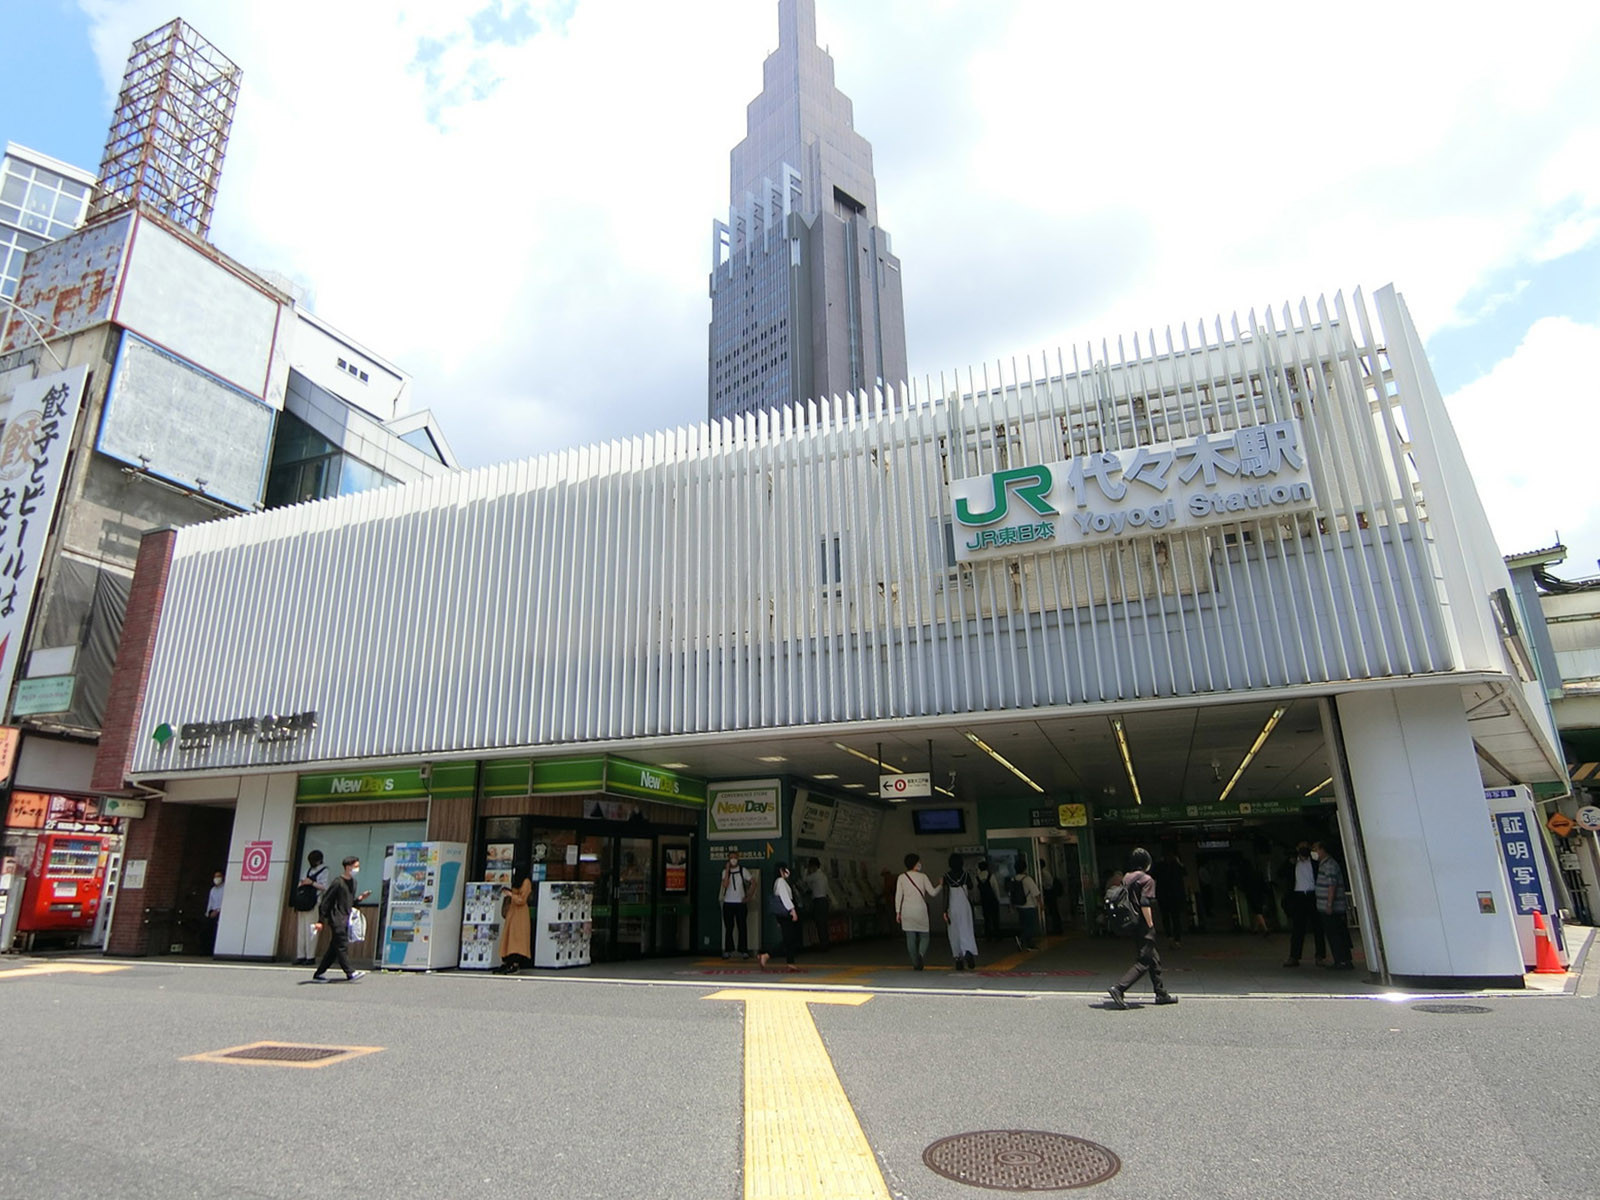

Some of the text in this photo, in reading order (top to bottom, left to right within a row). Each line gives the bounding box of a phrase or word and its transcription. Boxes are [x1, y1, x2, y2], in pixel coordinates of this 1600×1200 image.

[1067, 421, 1304, 507] 代々木駅
[955, 464, 1060, 527] JR
[1072, 481, 1312, 535] Yoyogi Station
[965, 520, 1055, 551] JR東日本
[330, 776, 394, 794] NewDays
[640, 770, 680, 794] NewDays
[717, 799, 775, 815] NewDays
[1500, 816, 1542, 911] 証明写真
